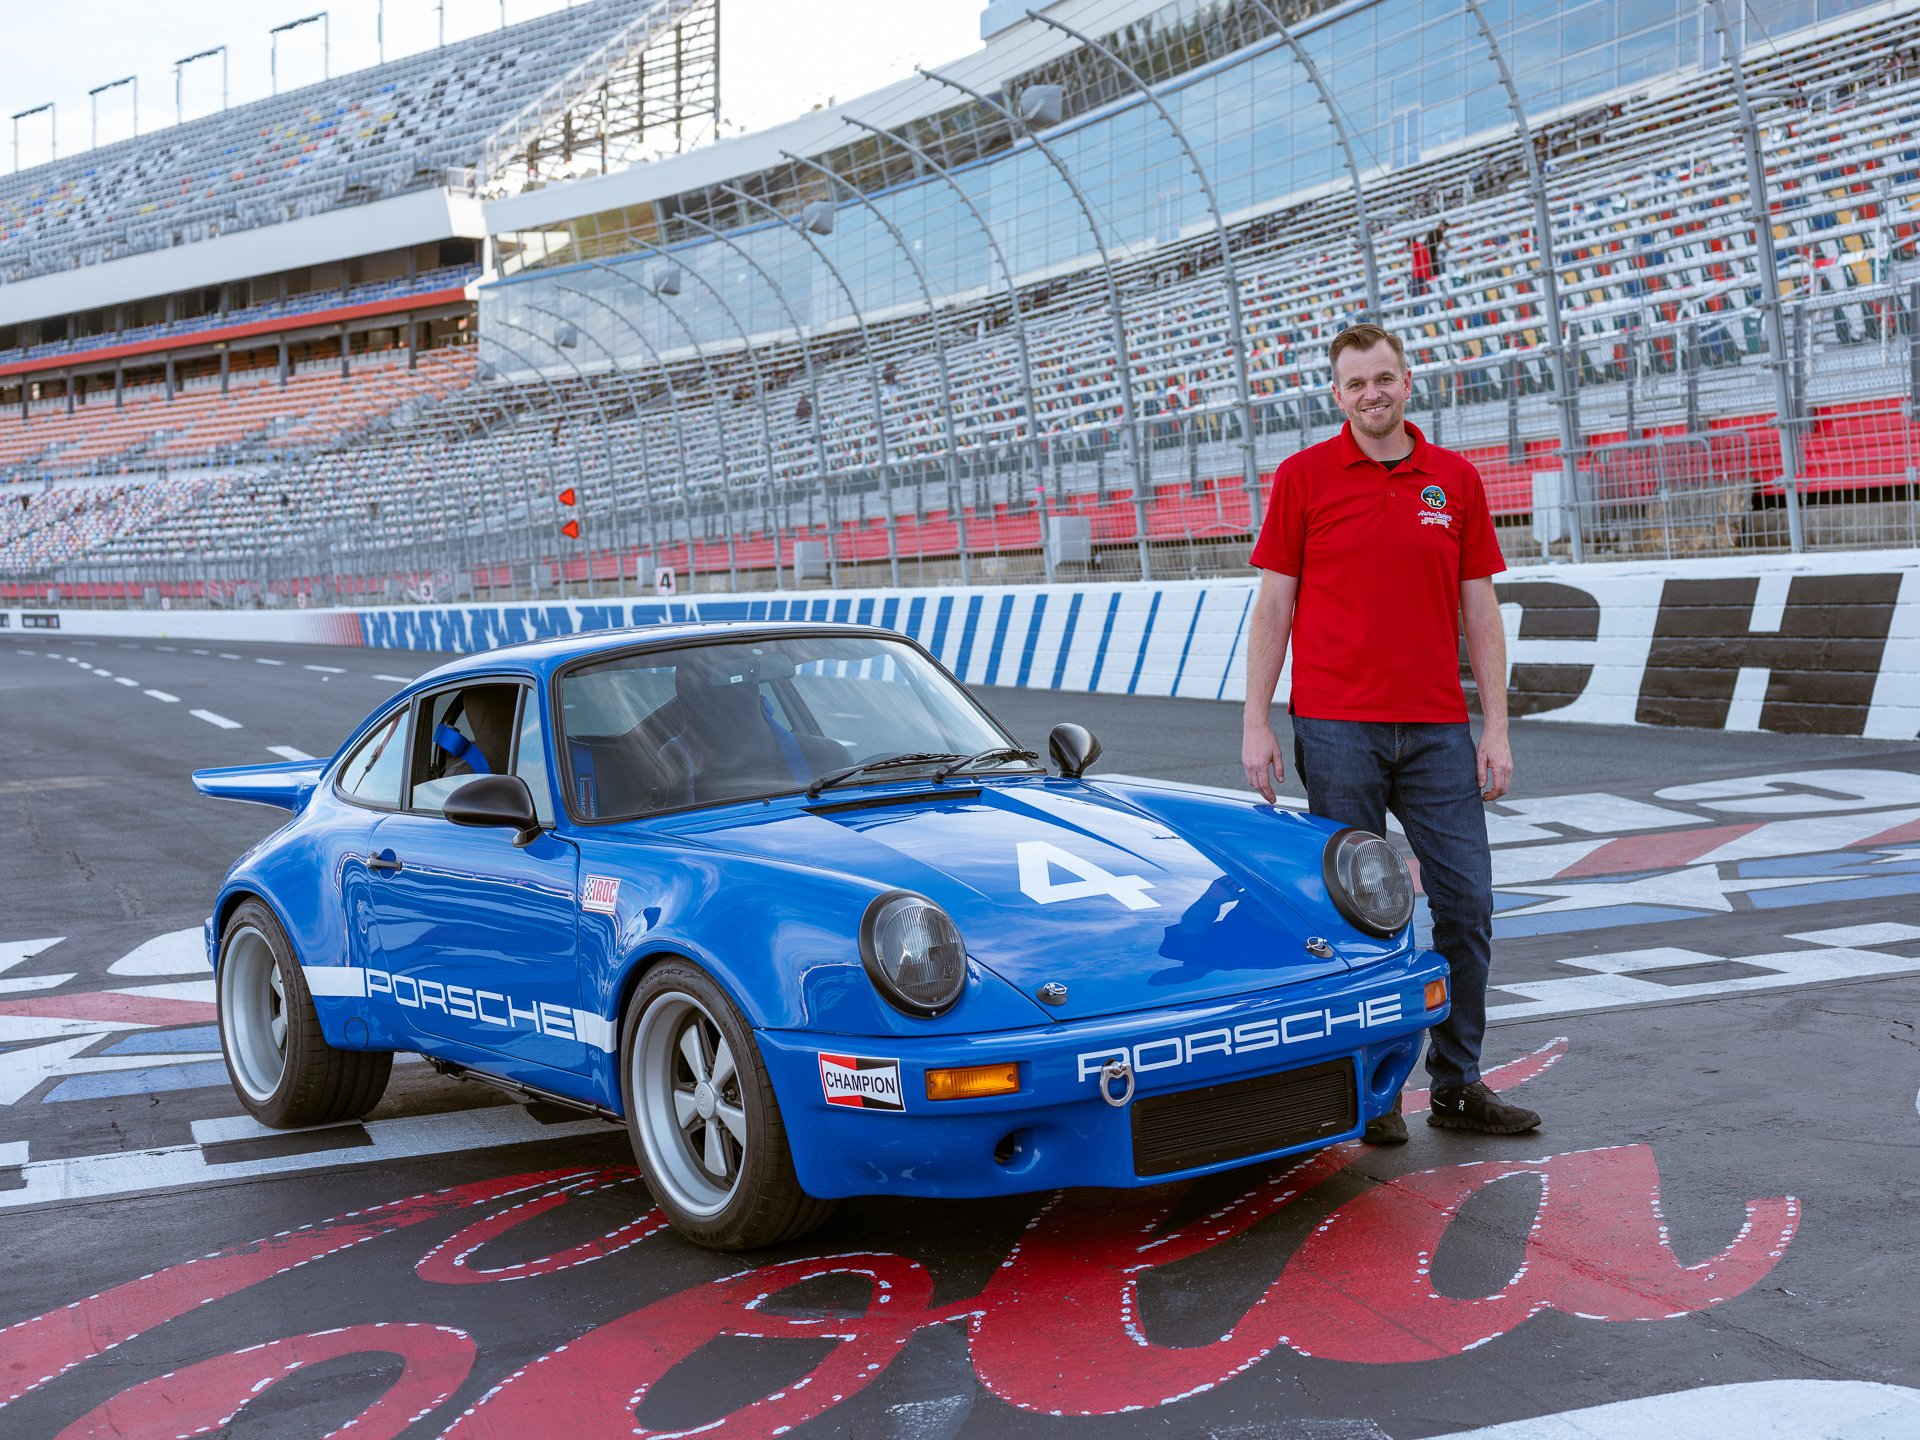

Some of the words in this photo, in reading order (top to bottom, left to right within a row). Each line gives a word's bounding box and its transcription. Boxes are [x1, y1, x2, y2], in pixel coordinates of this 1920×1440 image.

[1426, 497, 1442, 507] TLC
[423, 585, 431, 597] 3
[660, 572, 672, 589] 4
[1458, 573, 1920, 737] CH
[1016, 840, 1162, 911] 4
[592, 880, 617, 904] IROC
[640, 968, 685, 990] CONTACT
[366, 967, 576, 1041] PORSCHE
[1077, 993, 1402, 1082] PORSCHE
[826, 1072, 896, 1094] CHAMPION
